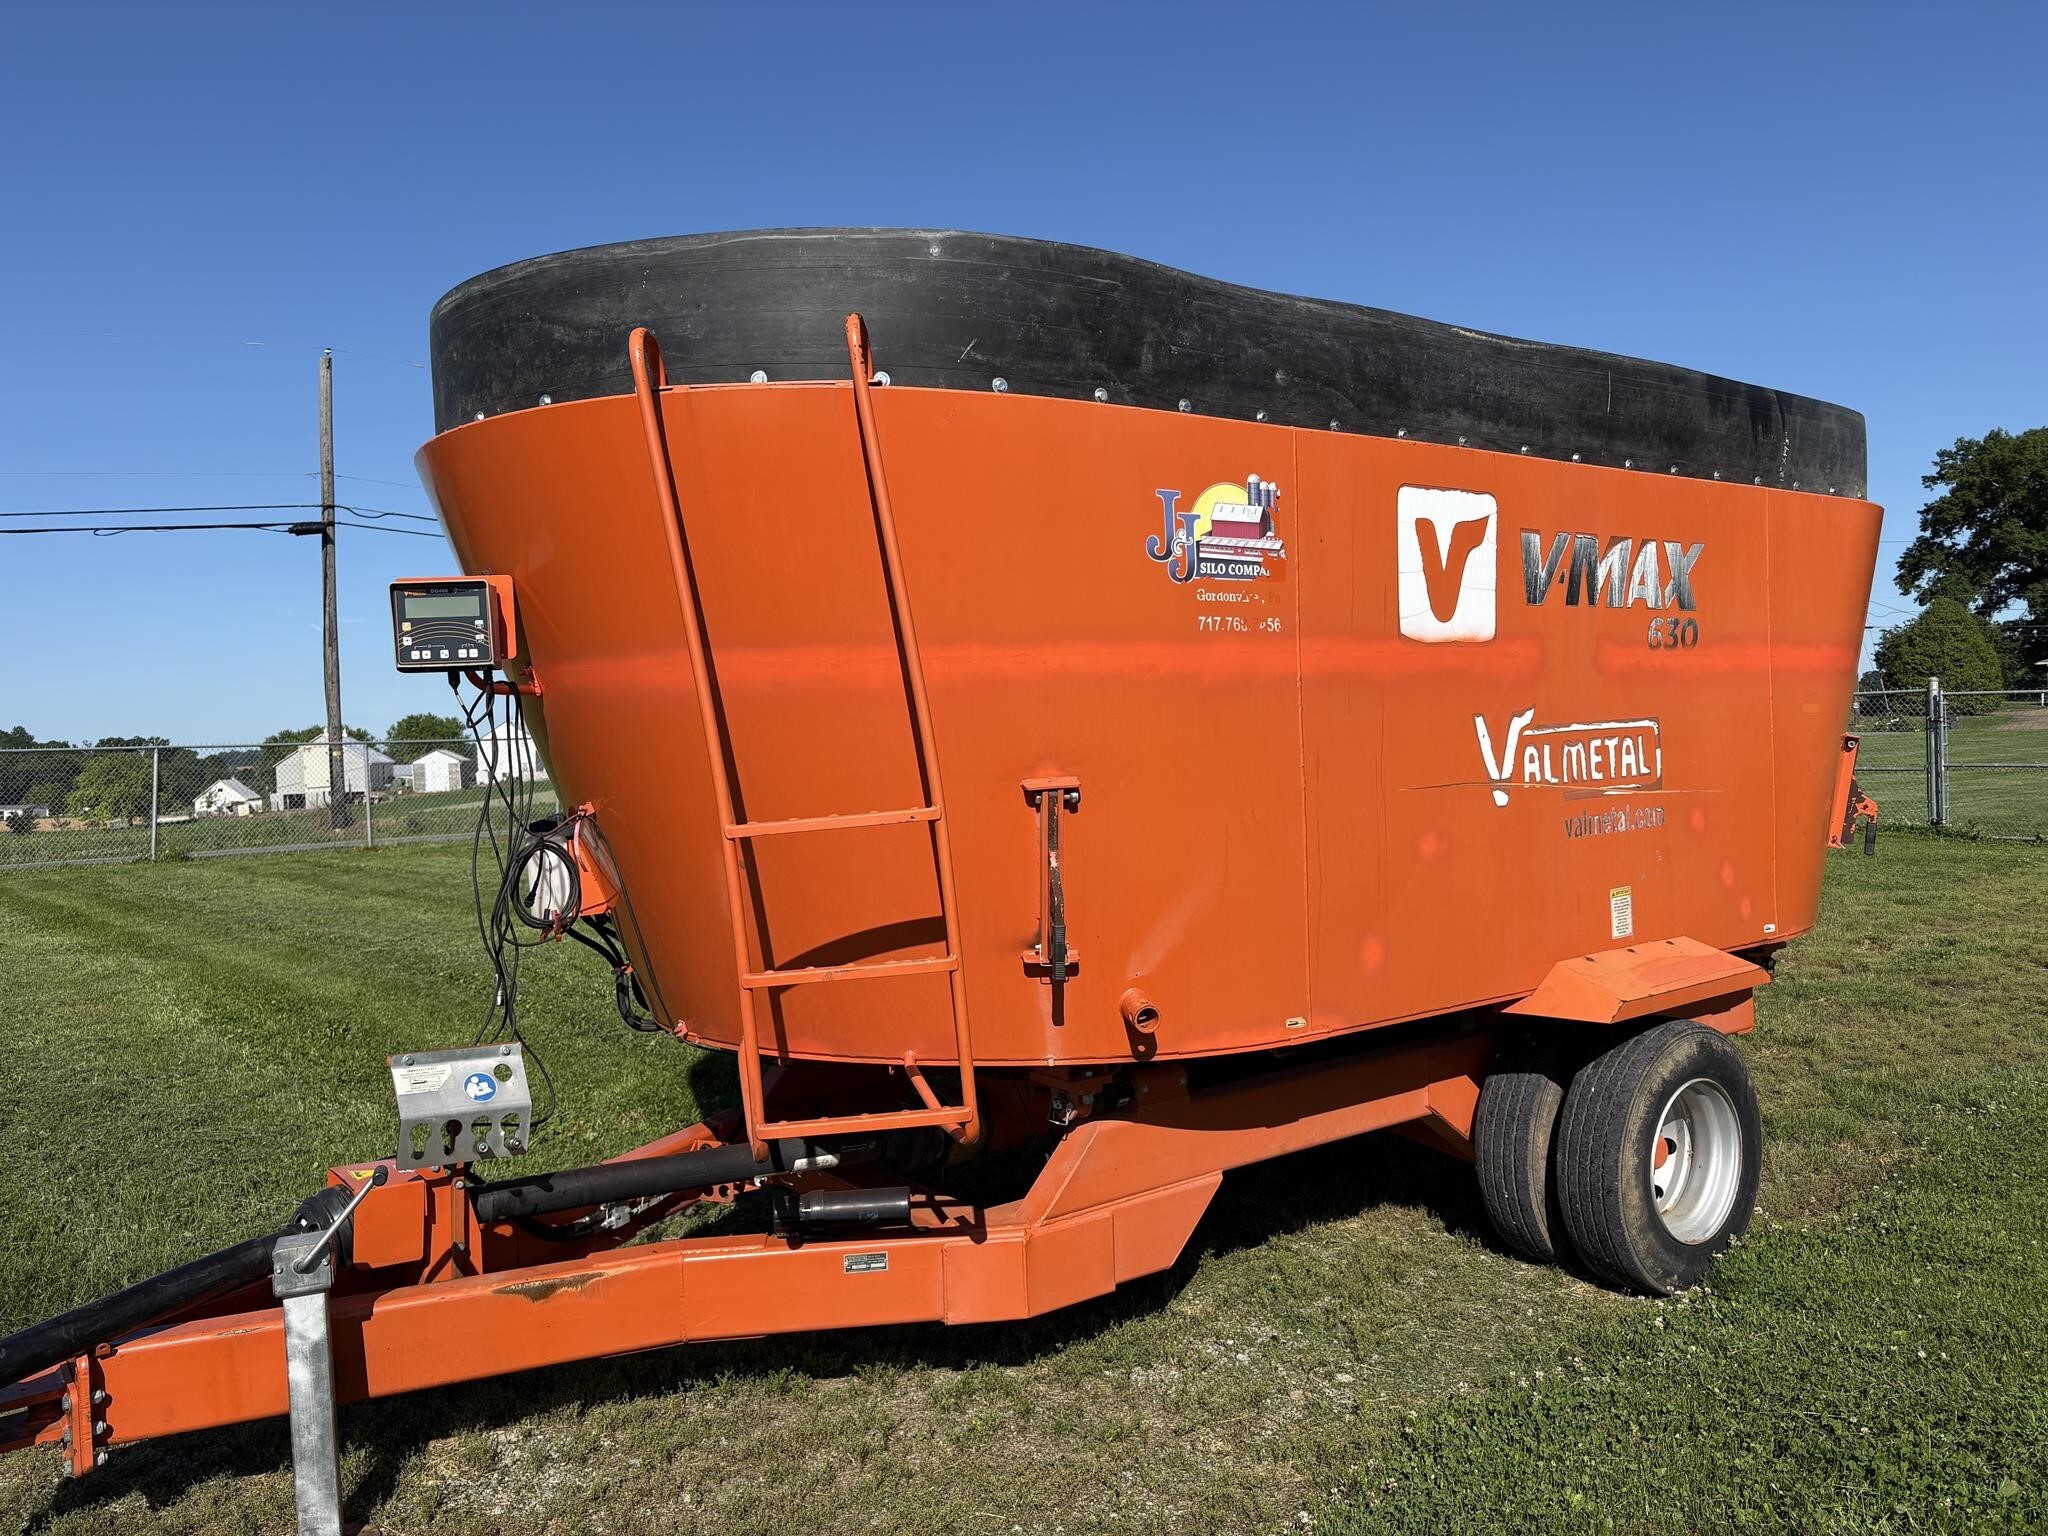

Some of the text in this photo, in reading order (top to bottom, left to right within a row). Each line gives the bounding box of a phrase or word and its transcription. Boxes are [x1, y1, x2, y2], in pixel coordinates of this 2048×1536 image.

[1200, 562, 1270, 577] SILO COMPA
[1198, 615, 1282, 632] 717.76.56
[1647, 616, 1699, 650] 630
[1473, 706, 1651, 807] VALMETAL
[1564, 803, 1665, 839] valmetal.com
